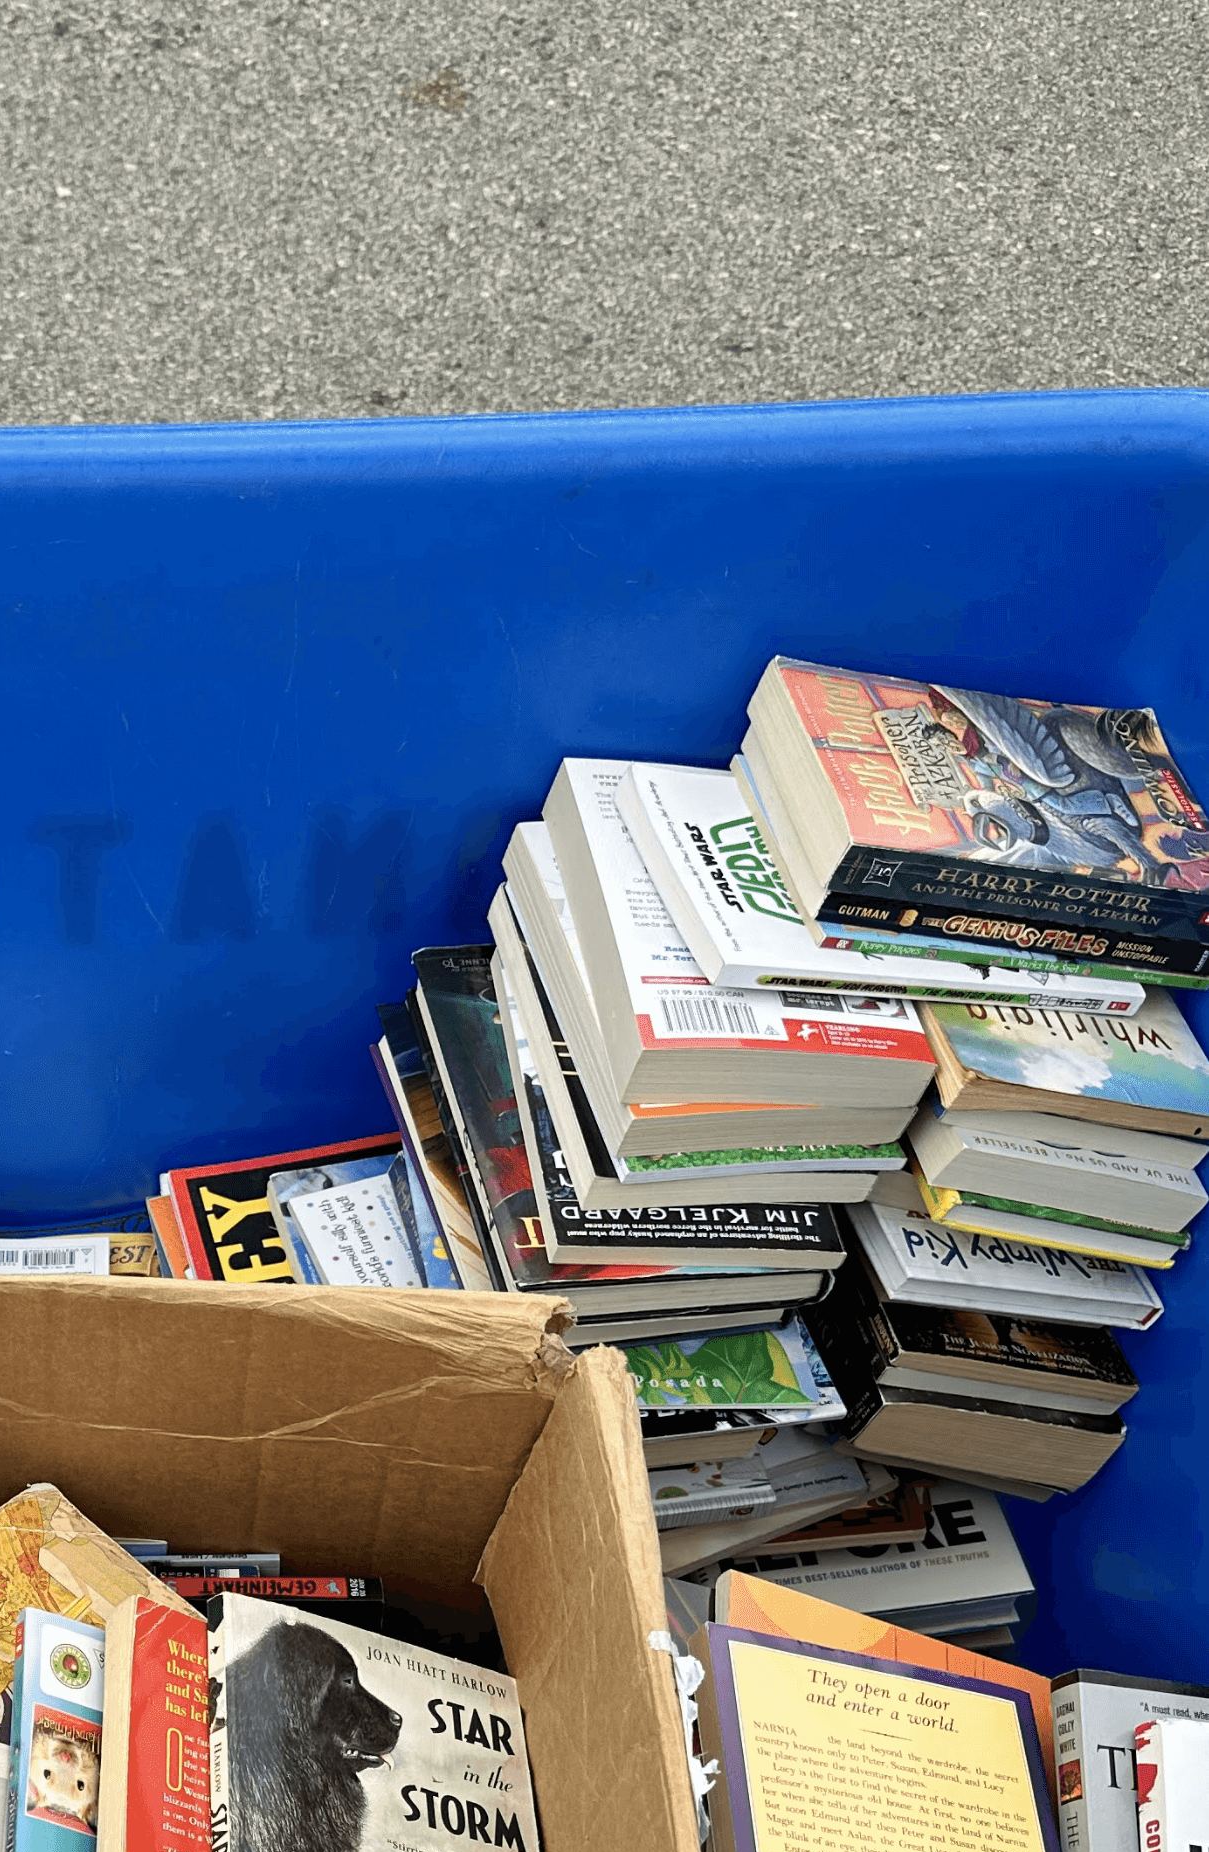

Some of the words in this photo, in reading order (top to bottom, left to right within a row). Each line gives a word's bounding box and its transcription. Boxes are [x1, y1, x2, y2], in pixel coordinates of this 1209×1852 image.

[935, 862, 1046, 898] HARRY
[1050, 880, 1152, 913] POTTER
[911, 881, 946, 896] AND
[950, 886, 984, 900] THE
[986, 890, 1061, 913] PRISONER
[1063, 902, 1086, 915] OF
[1088, 905, 1161, 927] AZKABAN
[837, 902, 890, 922] GUTMAN
[1116, 940, 1152, 954] MISSION
[1111, 947, 1169, 966] UNSTOPPABLE
[972, 1135, 1048, 1156] BESTSELLER
[1088, 1157, 1105, 1167] US
[1110, 1161, 1138, 1174] AND
[1143, 1167, 1162, 1179] UK
[1165, 1172, 1191, 1185] THE
[559, 1206, 749, 1223] KJELGAARD
[763, 1209, 818, 1226] JIM
[901, 1224, 967, 1269] Kid
[969, 1232, 1091, 1281] Wimpy
[1082, 1255, 1126, 1273] THE
[804, 1567, 869, 1582] BEST-SELLING
[869, 1562, 908, 1574] AUTHOR
[908, 1559, 922, 1568] OF
[923, 1556, 953, 1566] THESE
[953, 1550, 990, 1563] TRUTHS
[198, 1578, 317, 1598] GEMEINHART
[365, 1645, 402, 1668] JOAN
[406, 1659, 448, 1682] HIATT
[451, 1671, 508, 1701] HARLOW
[165, 1679, 191, 1698] and
[806, 1667, 849, 1695] They
[853, 1679, 891, 1704] open
[896, 1690, 908, 1703] a
[913, 1689, 951, 1712] door
[164, 1695, 188, 1716] has
[804, 1686, 837, 1708] and
[842, 1697, 884, 1718] enter
[889, 1708, 900, 1721] a
[905, 1708, 959, 1733] world.
[428, 1697, 515, 1756] STAR
[752, 1719, 797, 1737] NARNIA
[213, 1742, 222, 1793] HARLOW
[463, 1765, 483, 1788] in
[487, 1767, 514, 1794] the
[1065, 1811, 1080, 1848] THE
